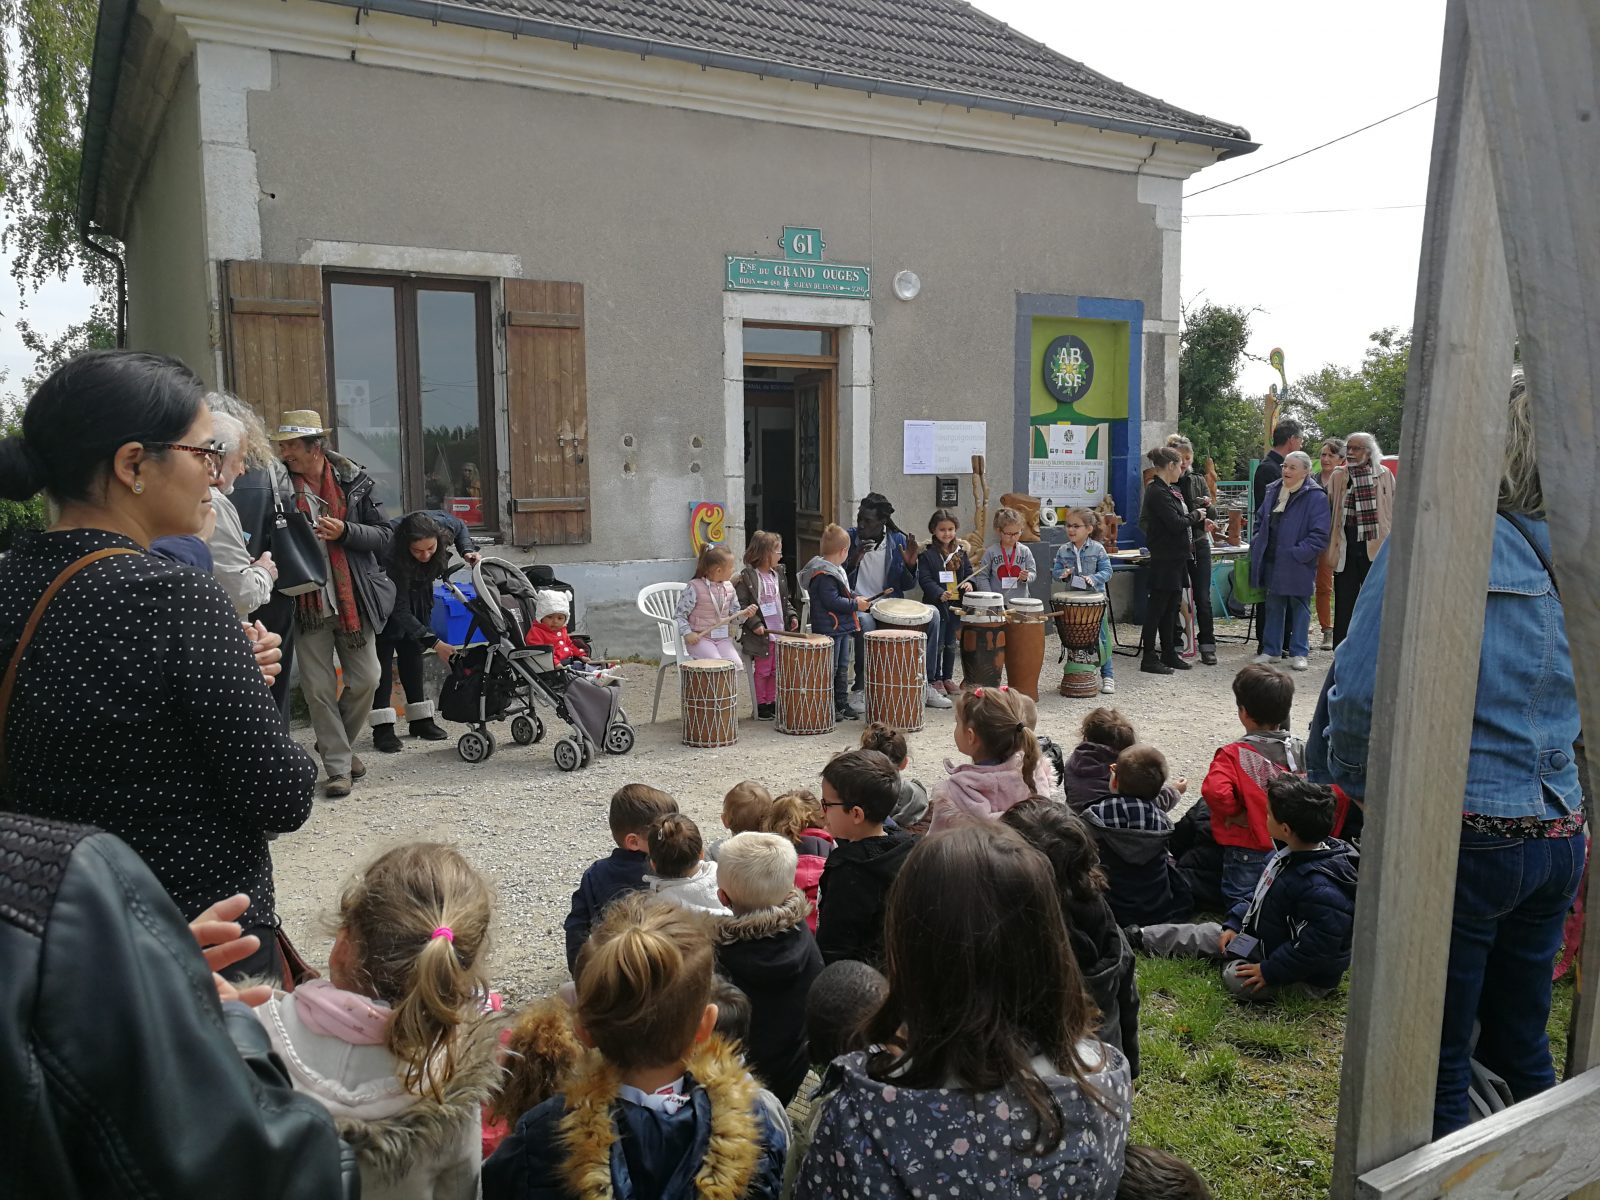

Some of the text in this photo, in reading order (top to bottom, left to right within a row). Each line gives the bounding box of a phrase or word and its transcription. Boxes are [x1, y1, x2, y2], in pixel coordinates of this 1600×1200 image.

[792, 233, 814, 255] 61
[774, 265, 815, 278] GRAND
[822, 269, 860, 282] OUGES
[1058, 347, 1082, 365] AB
